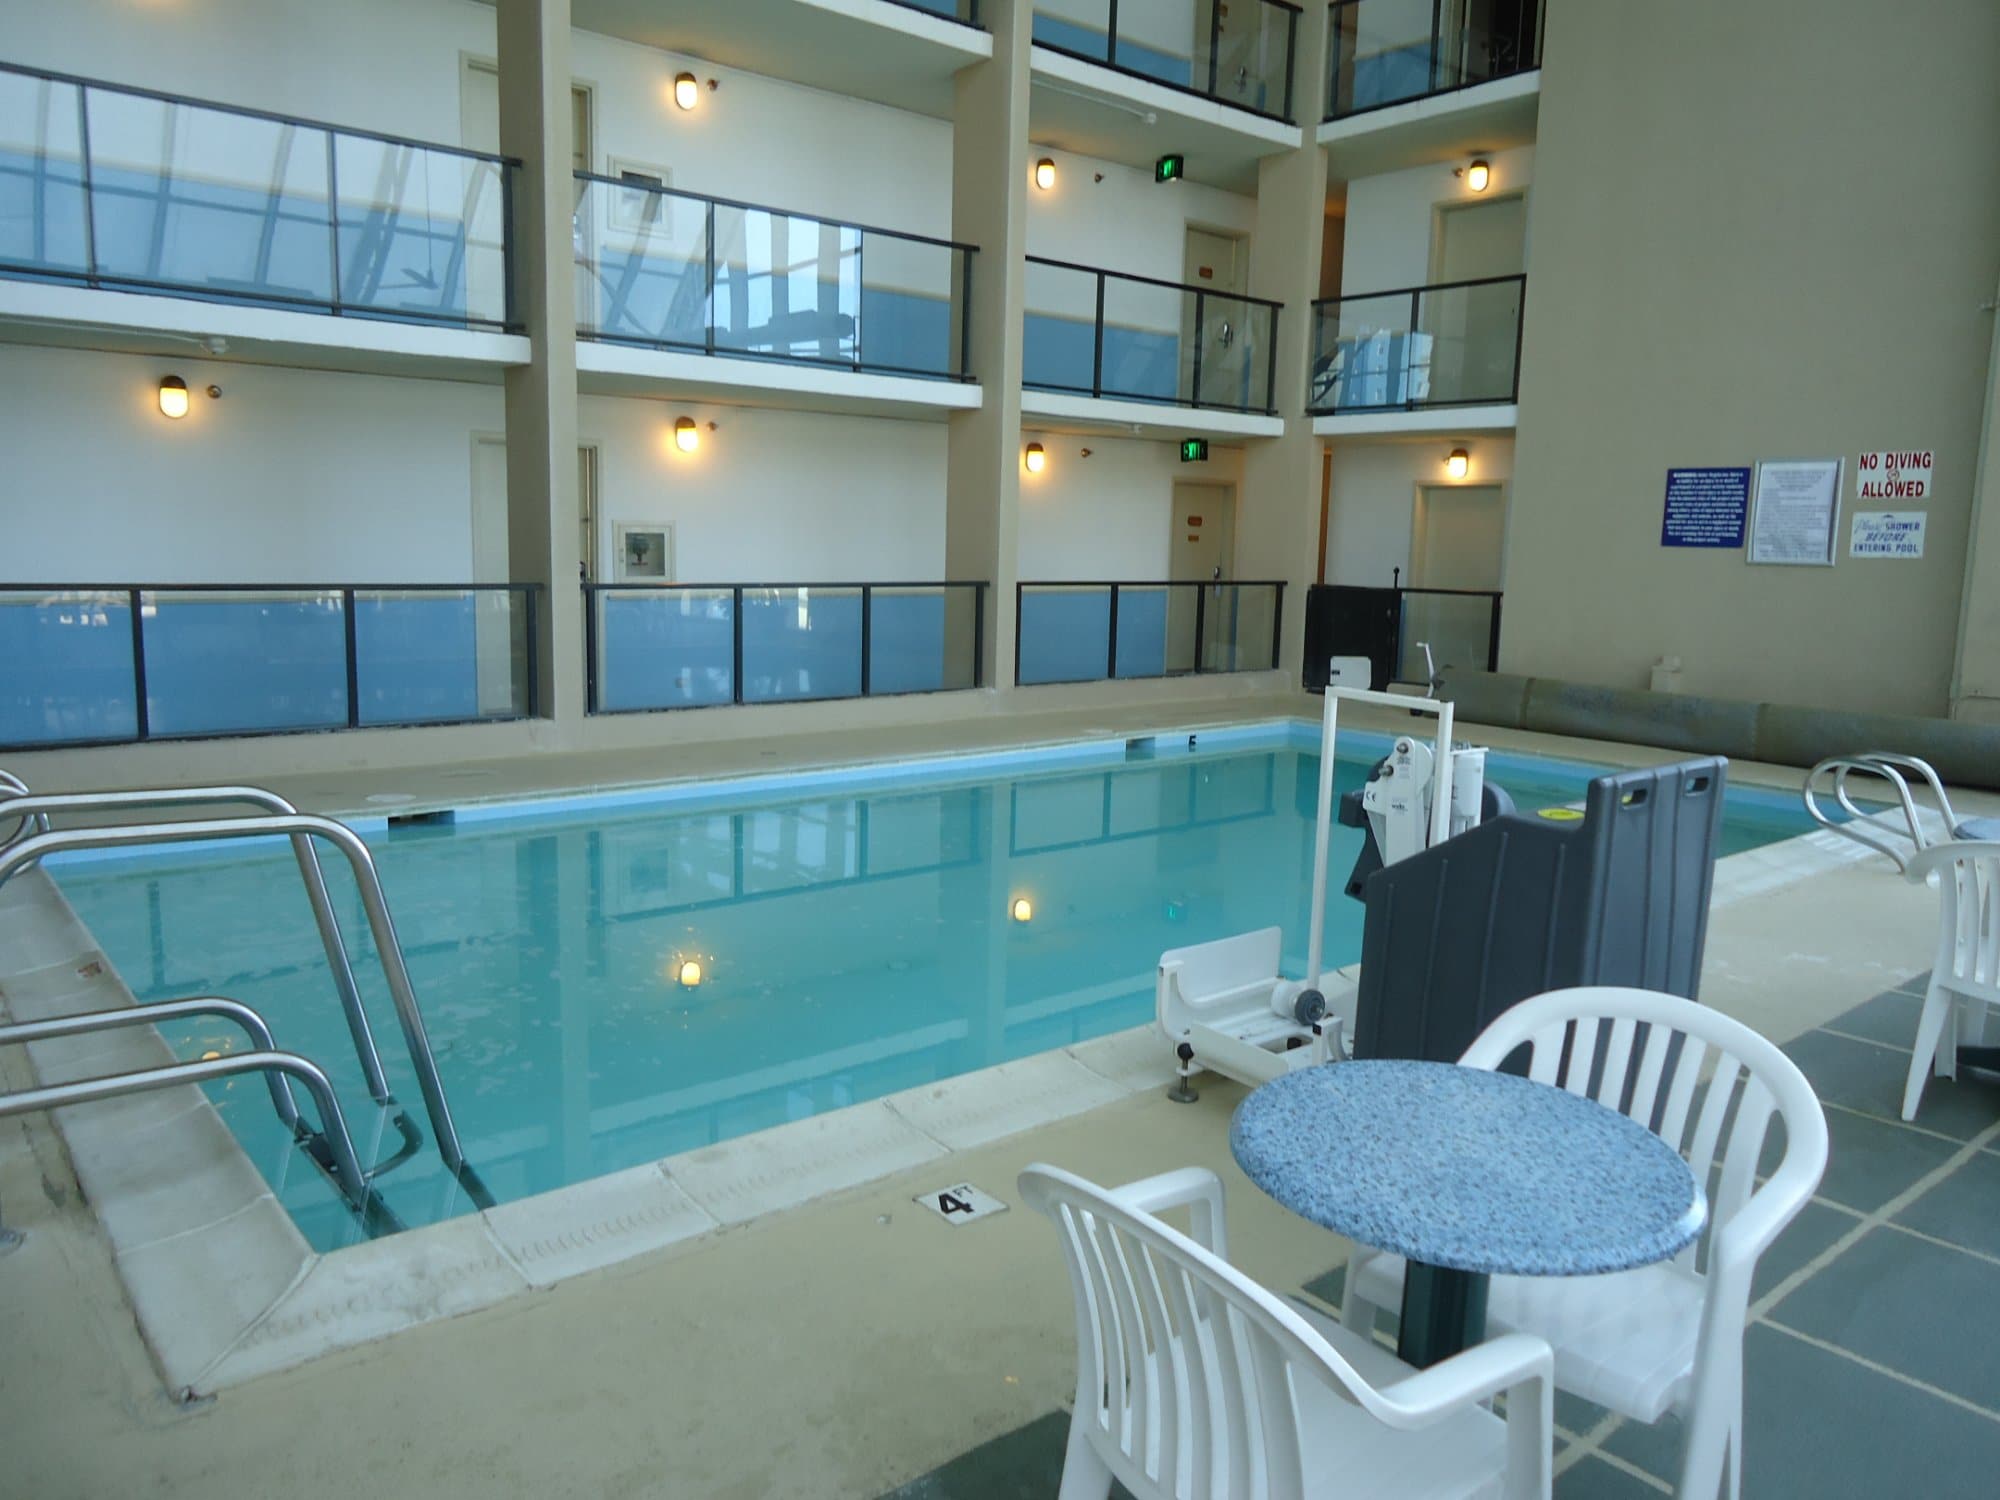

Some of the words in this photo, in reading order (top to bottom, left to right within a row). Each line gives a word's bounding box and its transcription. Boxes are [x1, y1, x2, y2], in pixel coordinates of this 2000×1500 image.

[1183, 442, 1201, 460] EXIT
[1860, 453, 1878, 470] NO
[1885, 452, 1931, 469] DIVING
[1862, 481, 1924, 497] ALLOWED
[1886, 521, 1920, 530] SHOWER
[1865, 532, 1906, 542] BEFORE
[1854, 543, 1891, 552] ENTERING
[1896, 543, 1918, 552] POOL
[939, 1193, 974, 1214] 4
